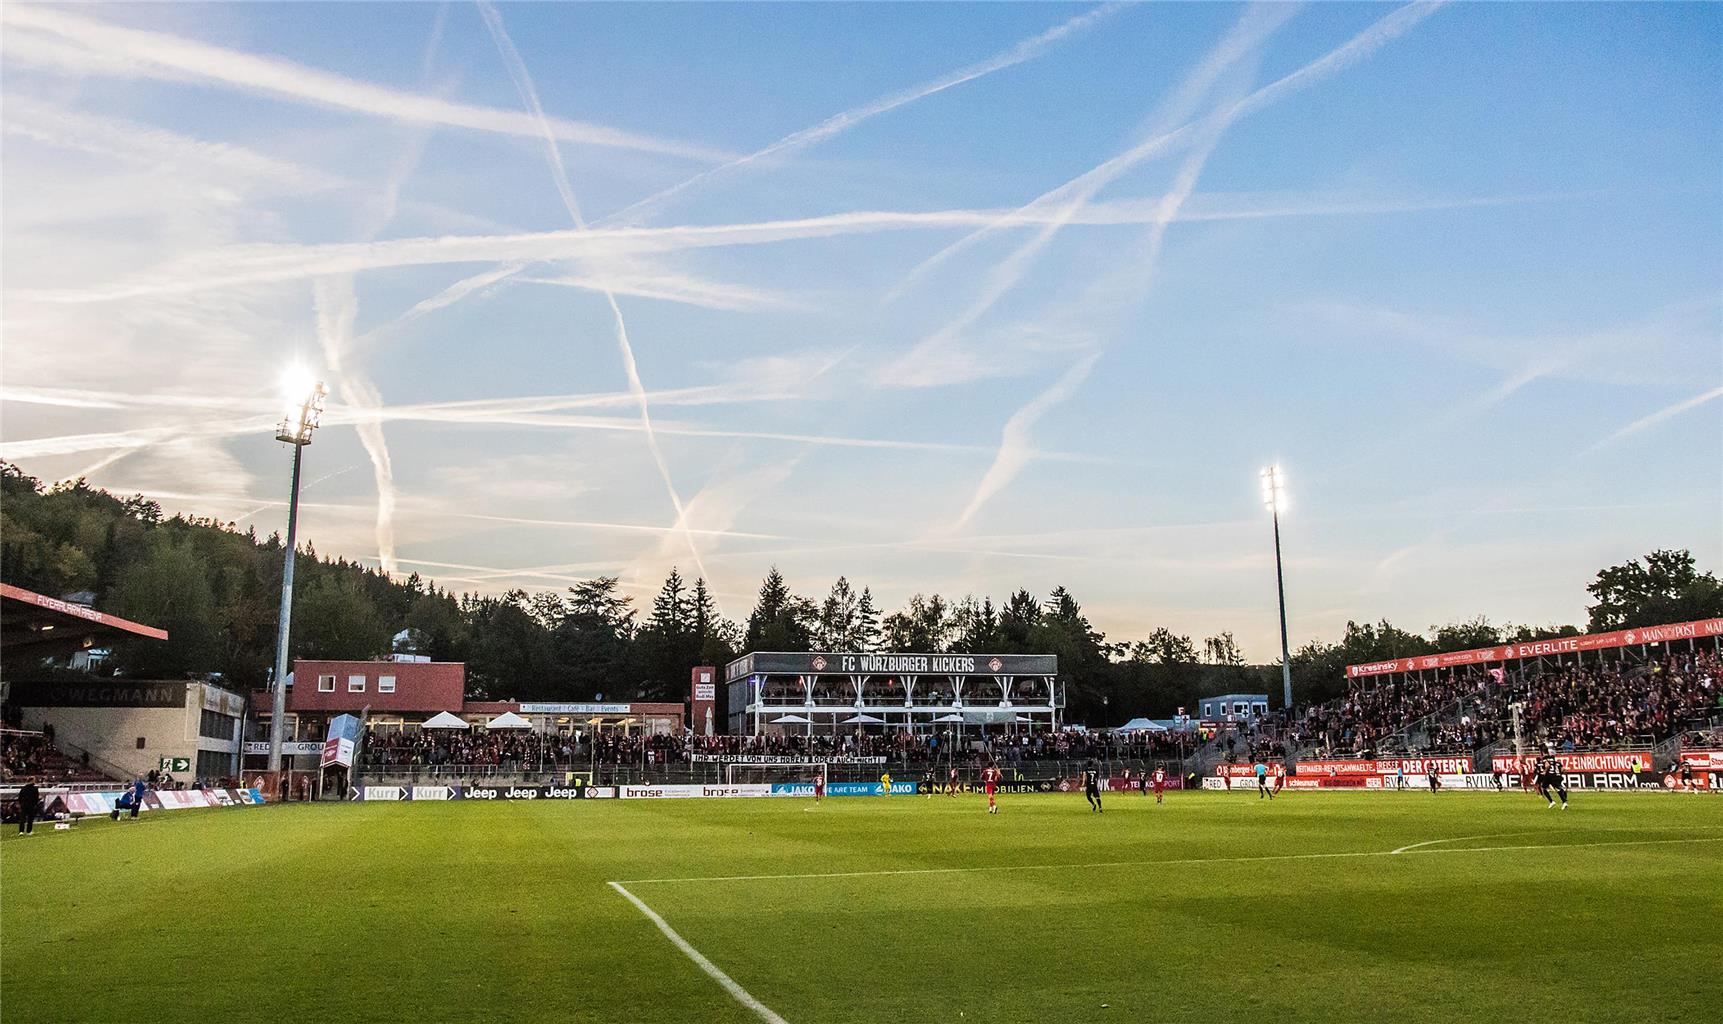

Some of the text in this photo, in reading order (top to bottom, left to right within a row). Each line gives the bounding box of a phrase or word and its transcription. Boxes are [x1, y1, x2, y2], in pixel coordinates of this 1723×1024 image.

[1642, 624, 1695, 641] MAIN POST
[1705, 621, 1723, 633] MAI
[1520, 639, 1578, 656] EVERLITE
[842, 653, 975, 672] FC WÜRZBURGER KICKERS
[1358, 662, 1398, 673] Kresinsky
[68, 687, 173, 702] WEGMANN
[297, 743, 324, 751] GROU
[746, 755, 762, 763] VON
[1402, 760, 1423, 773] DER
[368, 788, 395, 798] Kurr
[416, 788, 444, 798] Kurr
[465, 787, 497, 799] Jeep
[505, 787, 537, 799] Jeep
[545, 787, 577, 799] Jeep
[627, 787, 663, 797] brose
[791, 786, 815, 795] JAKO
